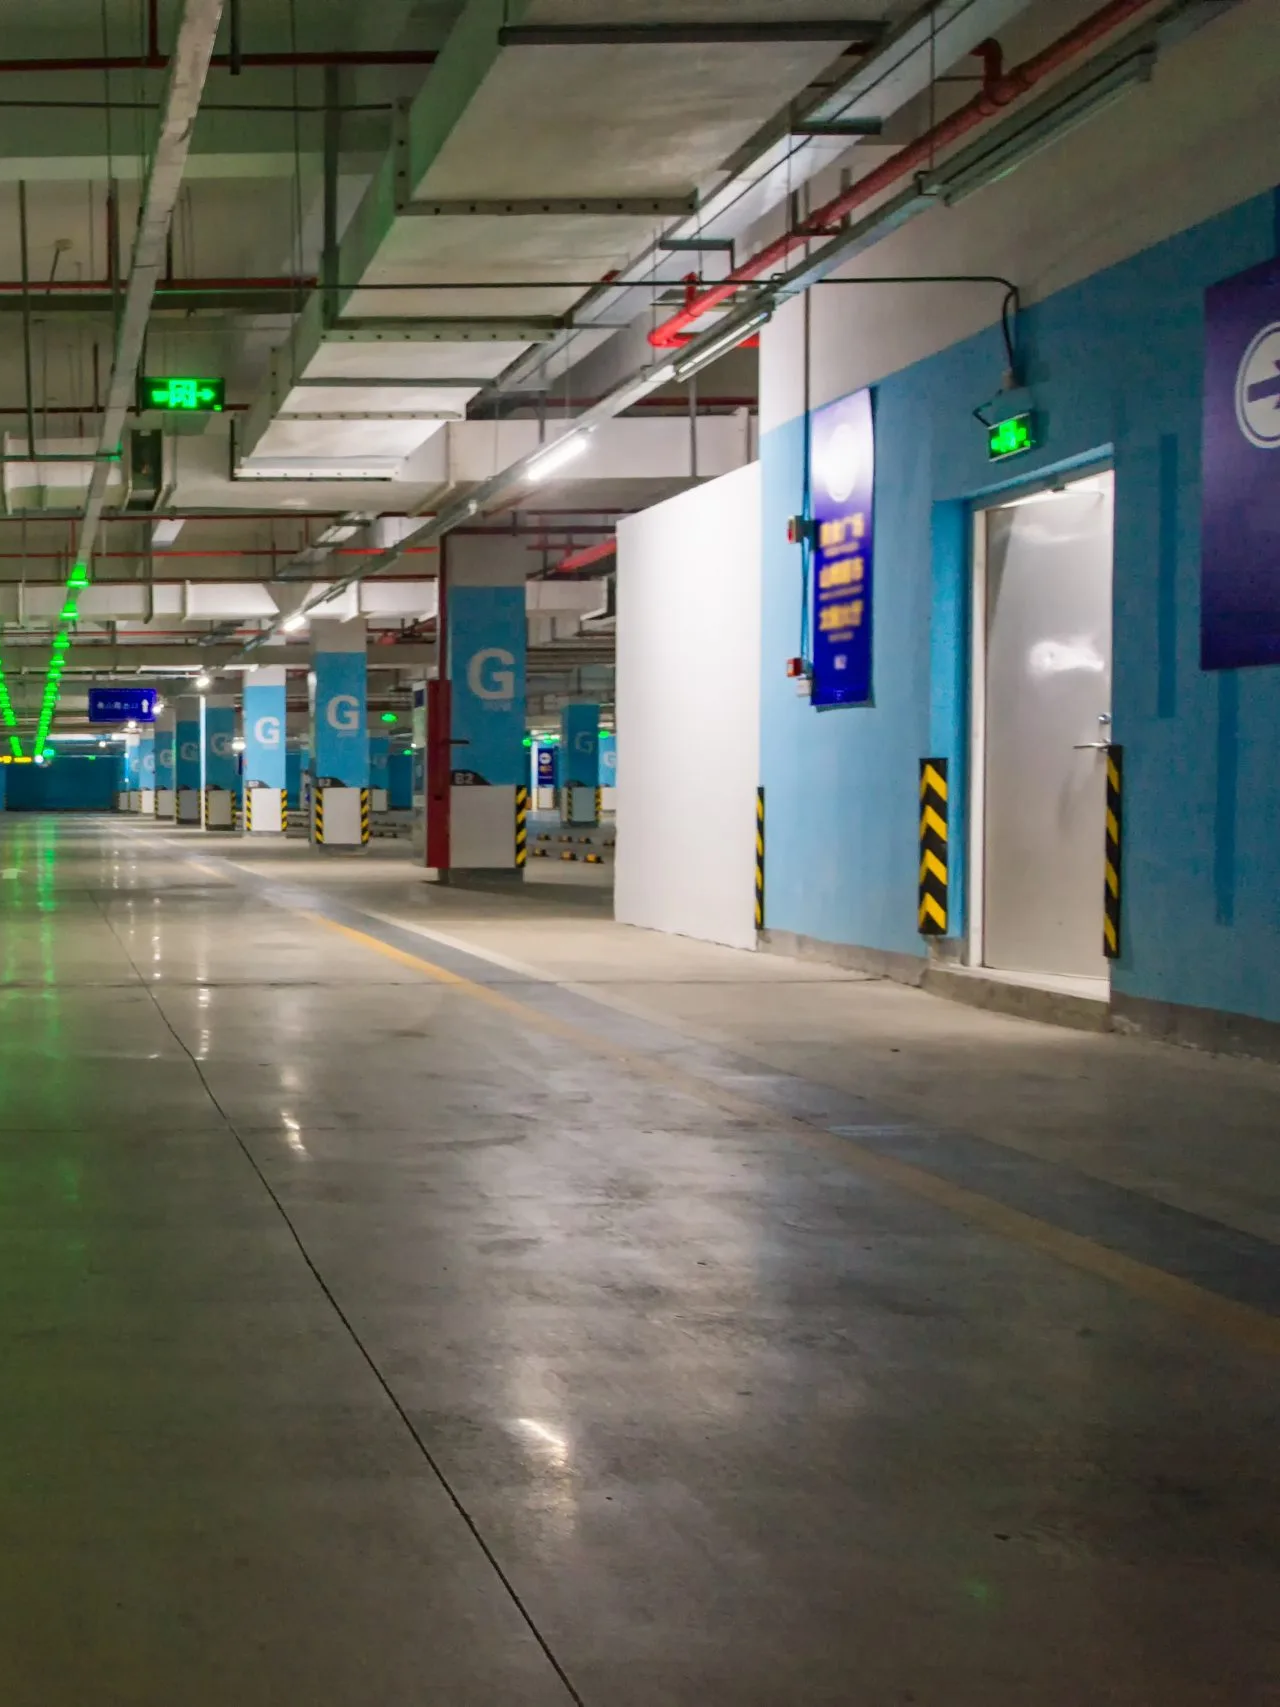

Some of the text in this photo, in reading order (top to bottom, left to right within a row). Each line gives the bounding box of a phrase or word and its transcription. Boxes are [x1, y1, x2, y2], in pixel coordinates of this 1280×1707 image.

[467, 648, 514, 699] G
[327, 695, 359, 730] G
[254, 716, 280, 744] G
[575, 731, 593, 752] G
[210, 732, 235, 758] G
[454, 773, 474, 784] B2
